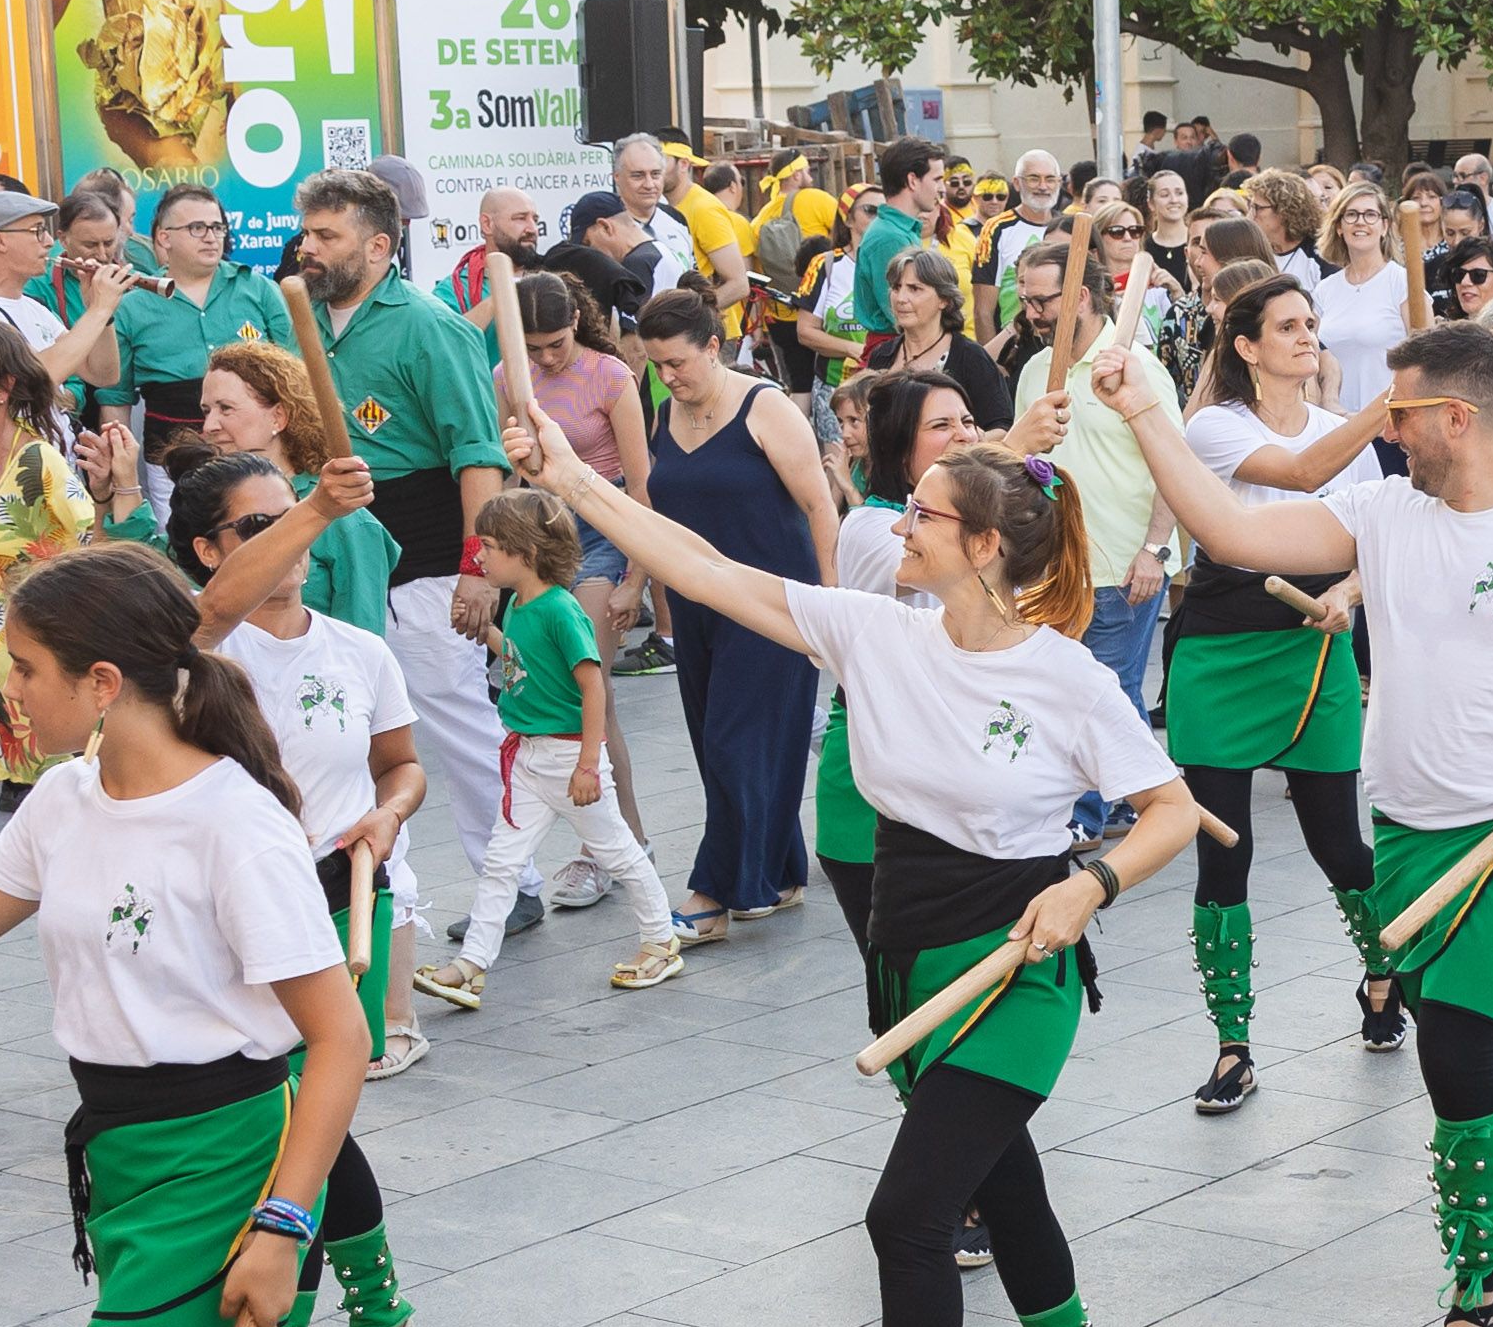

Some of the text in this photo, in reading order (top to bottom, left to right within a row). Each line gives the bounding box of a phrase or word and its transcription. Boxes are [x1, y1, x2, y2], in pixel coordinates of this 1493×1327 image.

[437, 38, 578, 66] DE SETEM
[429, 88, 580, 130] 3a SomVall
[428, 153, 504, 170] CAMINADA
[508, 149, 576, 168] SOLIDÀRIA
[580, 151, 604, 165] PER
[436, 177, 492, 194] CONTRA
[515, 173, 567, 190] CÀNCER
[571, 175, 581, 188] A
[248, 215, 264, 229] de
[265, 211, 300, 232] juny
[239, 233, 282, 249] Xarau
